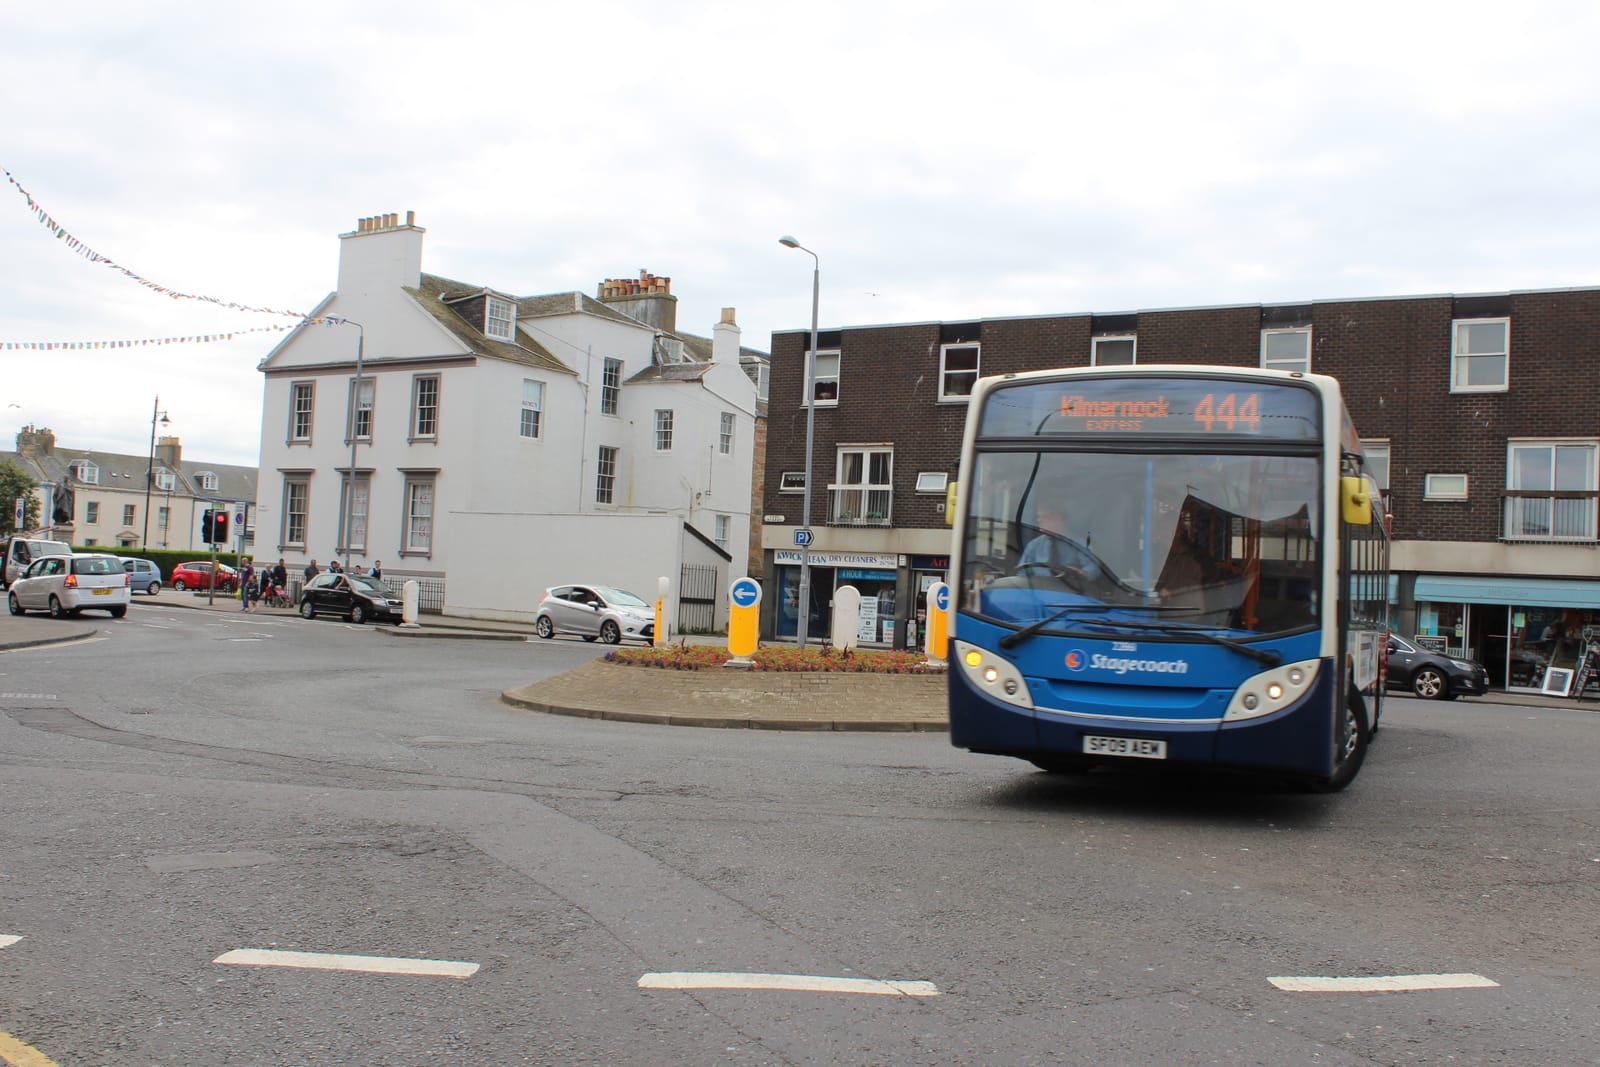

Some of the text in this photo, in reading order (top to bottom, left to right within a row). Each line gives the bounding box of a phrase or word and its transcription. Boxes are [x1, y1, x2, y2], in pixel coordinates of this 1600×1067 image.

[1060, 393, 1261, 432] Kilmarnock 444
[798, 533, 805, 543] P
[828, 554, 842, 562] DRY
[844, 555, 878, 564] CLEANERS
[1089, 654, 1188, 674] Stagecoach
[1090, 737, 1159, 756] SF09 AEW
